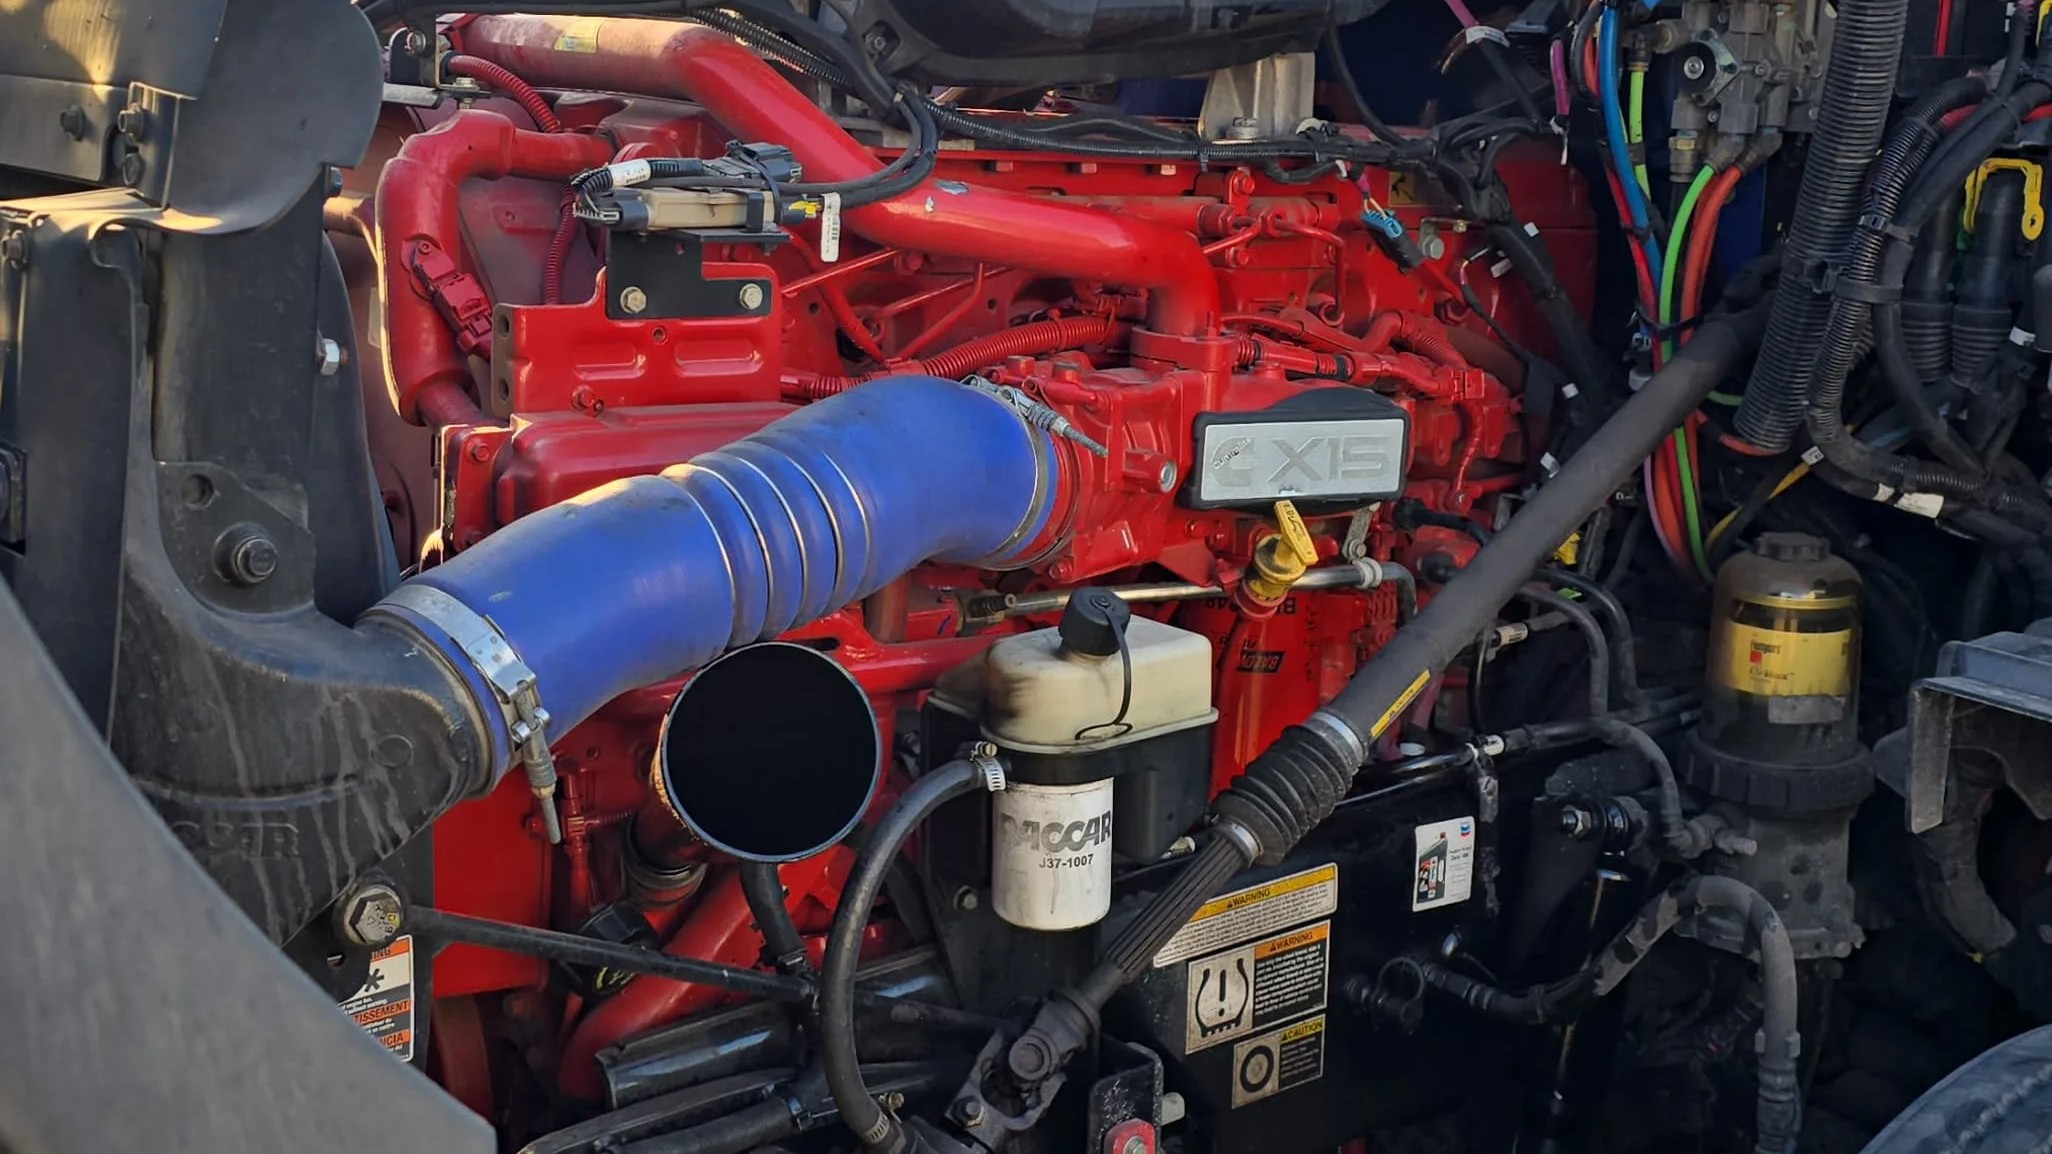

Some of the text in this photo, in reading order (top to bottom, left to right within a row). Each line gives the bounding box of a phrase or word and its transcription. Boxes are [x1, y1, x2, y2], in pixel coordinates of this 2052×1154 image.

[1266, 436, 1391, 482] X15
[1039, 854, 1094, 868] J37-1007
[1232, 888, 1271, 906] WARNING
[1277, 931, 1313, 949] WARNING
[1287, 1021, 1323, 1037] CAUTION
